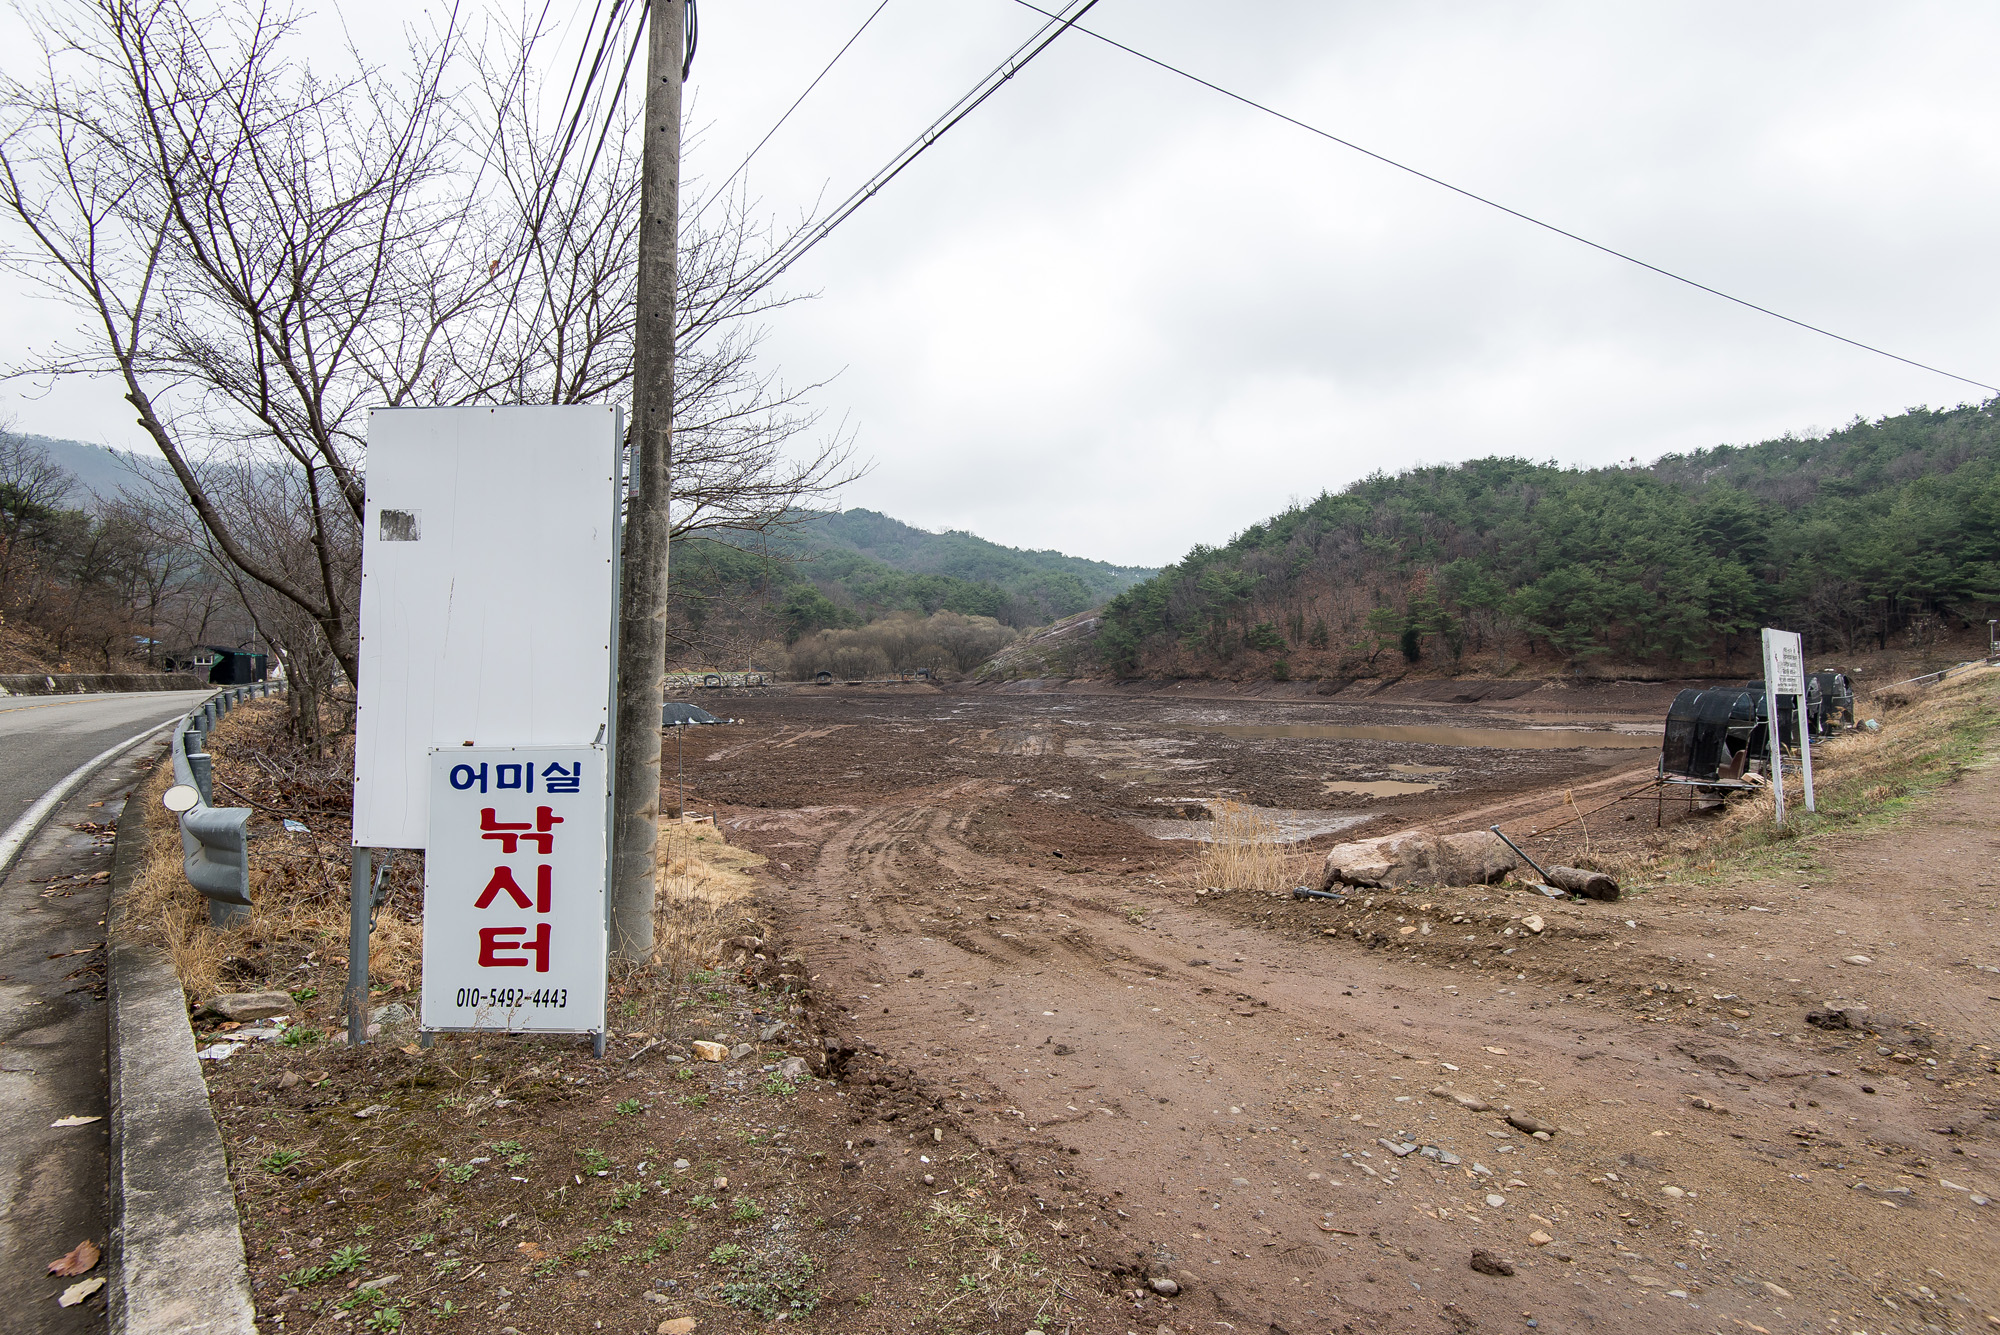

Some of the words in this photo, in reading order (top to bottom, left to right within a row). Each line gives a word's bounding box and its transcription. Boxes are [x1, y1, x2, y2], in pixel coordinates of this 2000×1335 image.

[449, 761, 582, 794] 어미실
[474, 806, 564, 972] 낚시터
[456, 988, 568, 1008] 010-5492-4443
